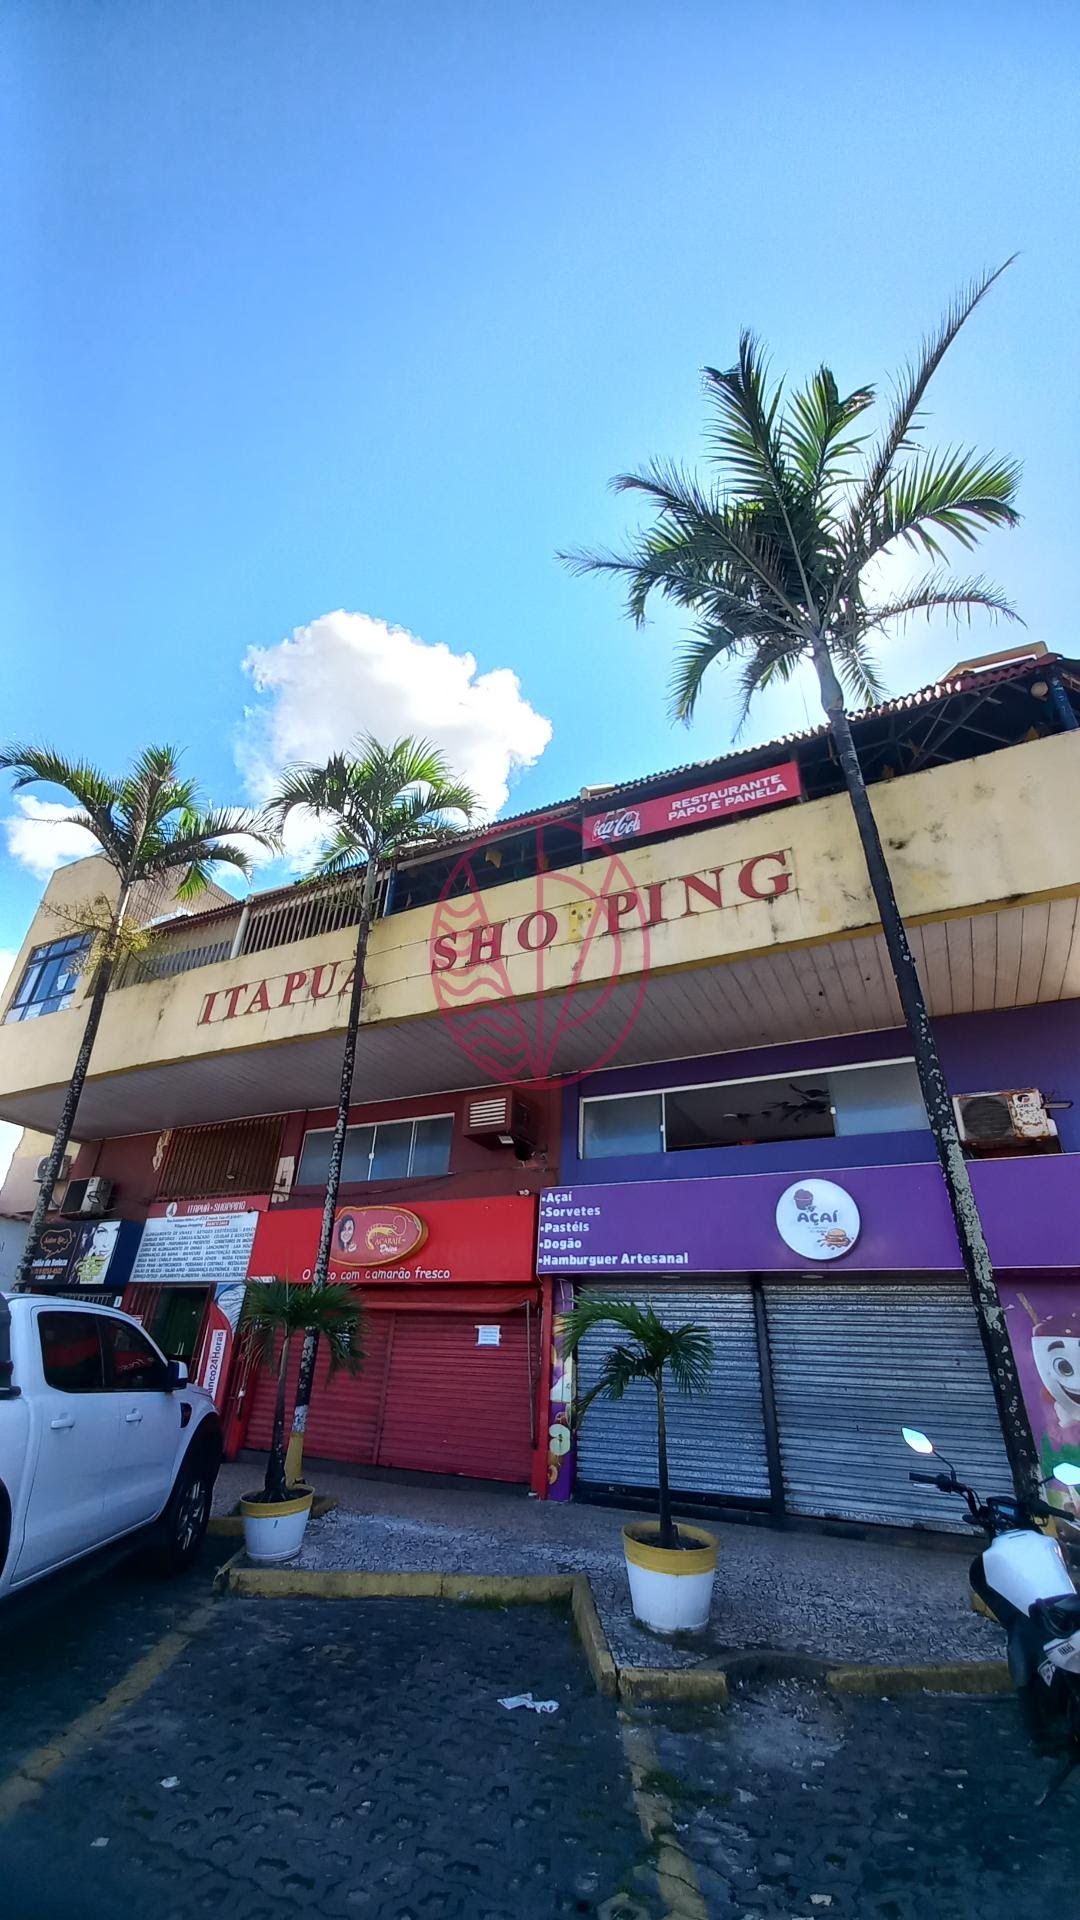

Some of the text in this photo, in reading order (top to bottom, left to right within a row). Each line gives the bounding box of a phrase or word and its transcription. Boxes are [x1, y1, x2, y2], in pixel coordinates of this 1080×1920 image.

[672, 774, 782, 811] RESTAURANTE
[668, 783, 788, 821] PAPO E PANELA
[592, 811, 641, 841] Coca-Cola
[546, 1191, 573, 1205] Açaí
[545, 1206, 601, 1217] Sorvetes
[797, 1209, 839, 1226] AÇAÍ
[544, 1221, 590, 1233] Pastéis
[543, 1237, 582, 1250] Dogão
[543, 1252, 689, 1266] Hamburguer Artesanal
[302, 1268, 311, 1281] O
[340, 1270, 360, 1281] com
[364, 1266, 412, 1280] camarão
[414, 1265, 451, 1280] fresco
[207, 1331, 224, 1395] anco24Horas
